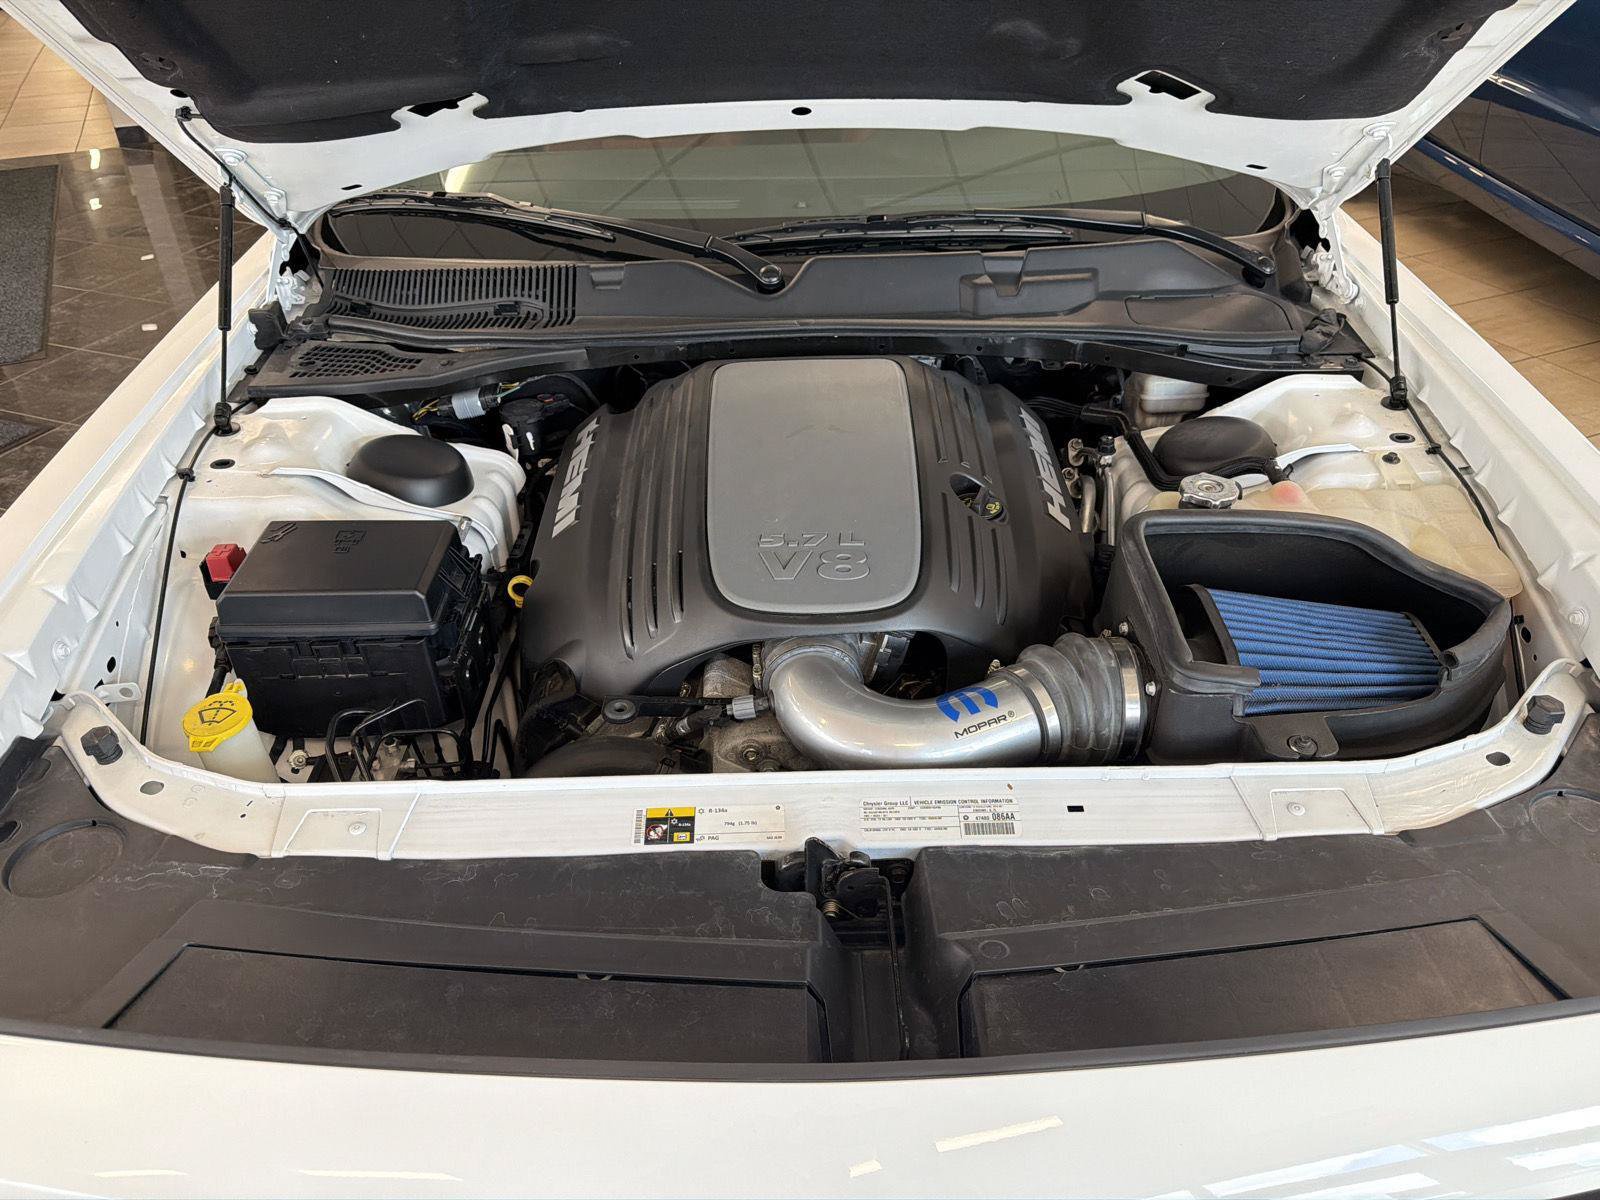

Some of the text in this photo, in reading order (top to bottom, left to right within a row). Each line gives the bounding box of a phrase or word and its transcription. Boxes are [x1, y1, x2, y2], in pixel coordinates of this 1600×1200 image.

[552, 417, 600, 538] HEMI
[1018, 406, 1071, 529] HEMI
[758, 549, 870, 580] V8
[953, 714, 1008, 739] MOPAR
